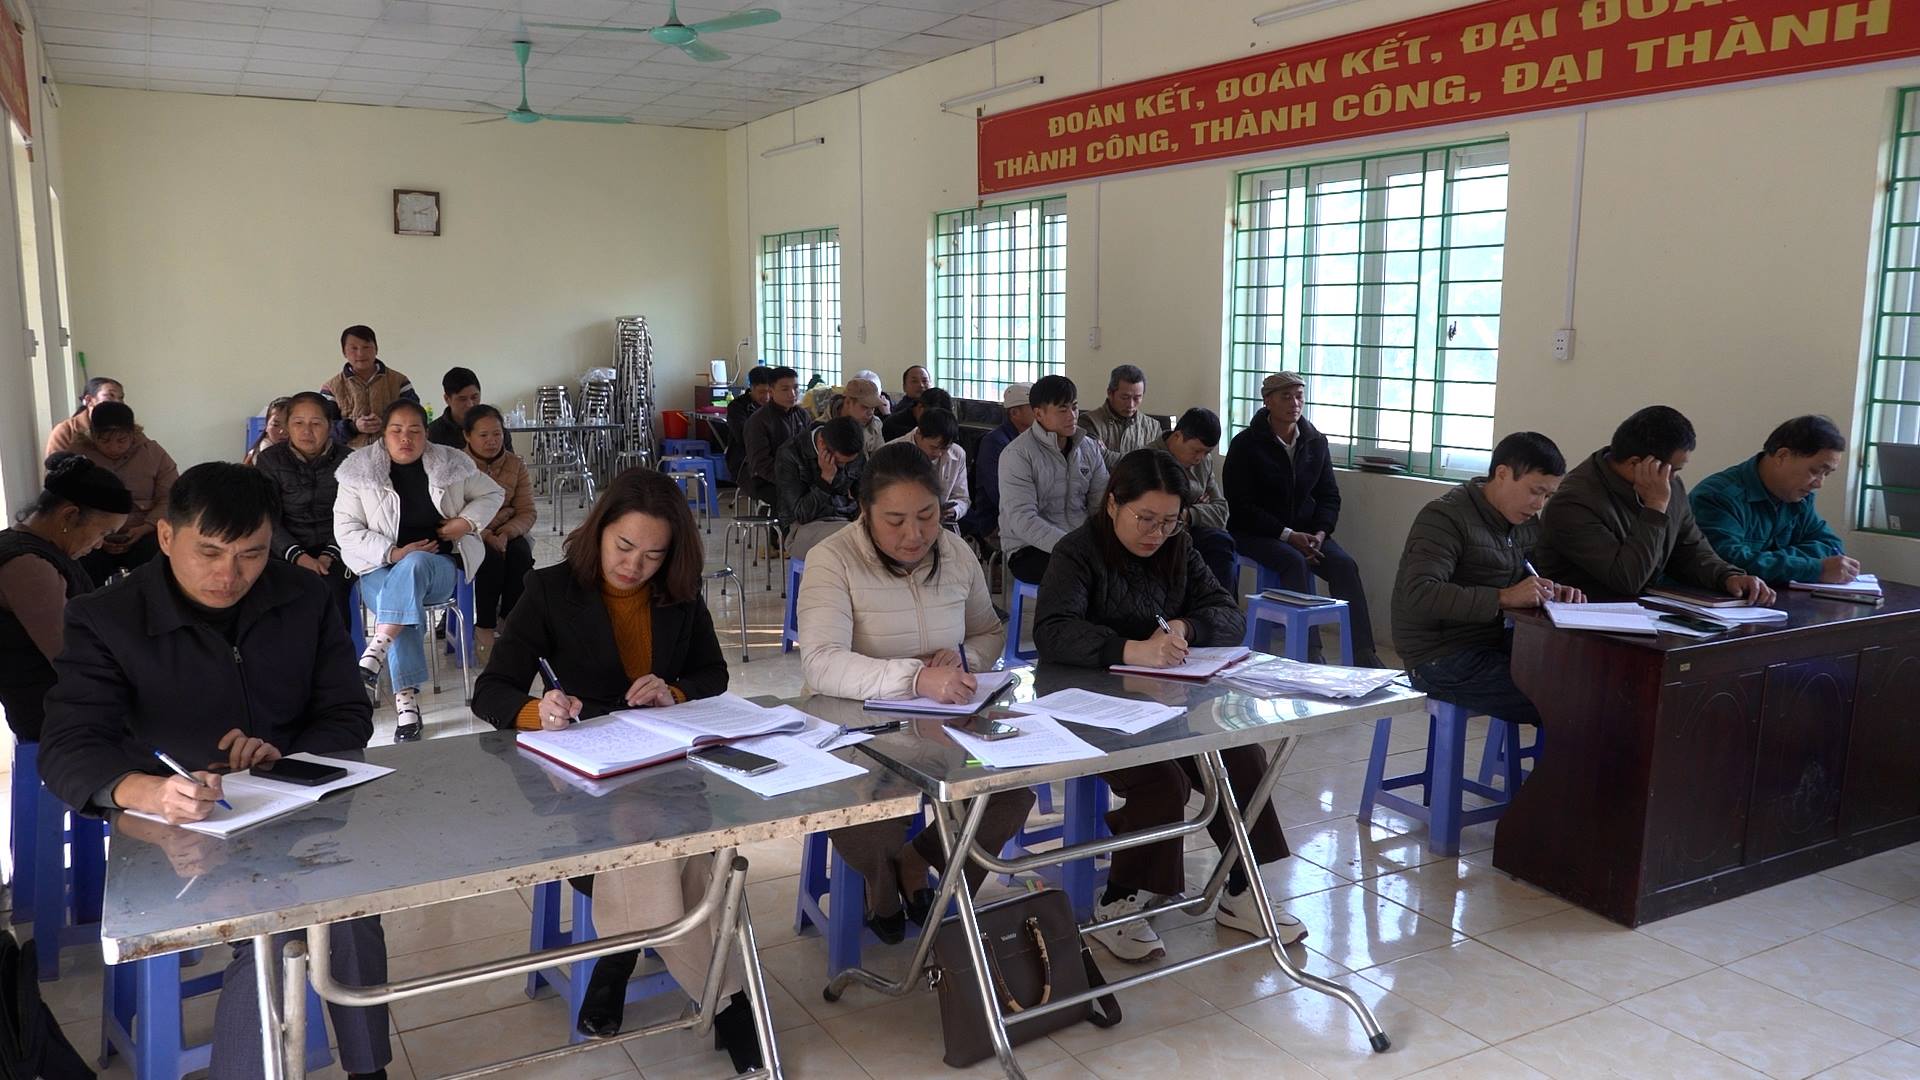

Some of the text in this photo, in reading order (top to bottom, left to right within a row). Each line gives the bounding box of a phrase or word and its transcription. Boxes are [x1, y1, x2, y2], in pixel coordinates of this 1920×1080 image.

[994, 0, 1891, 179] THÀNH CÔNG, THÀNH CÔNG, ĐẠI THÀNH
[1048, 102, 1125, 137] ĐOÀN
[1135, 82, 1205, 119] KẾT,
[1216, 58, 1327, 103] ĐOÀN
[1341, 31, 1443, 78] KẾT,
[1461, 8, 1560, 54] ĐẠI
